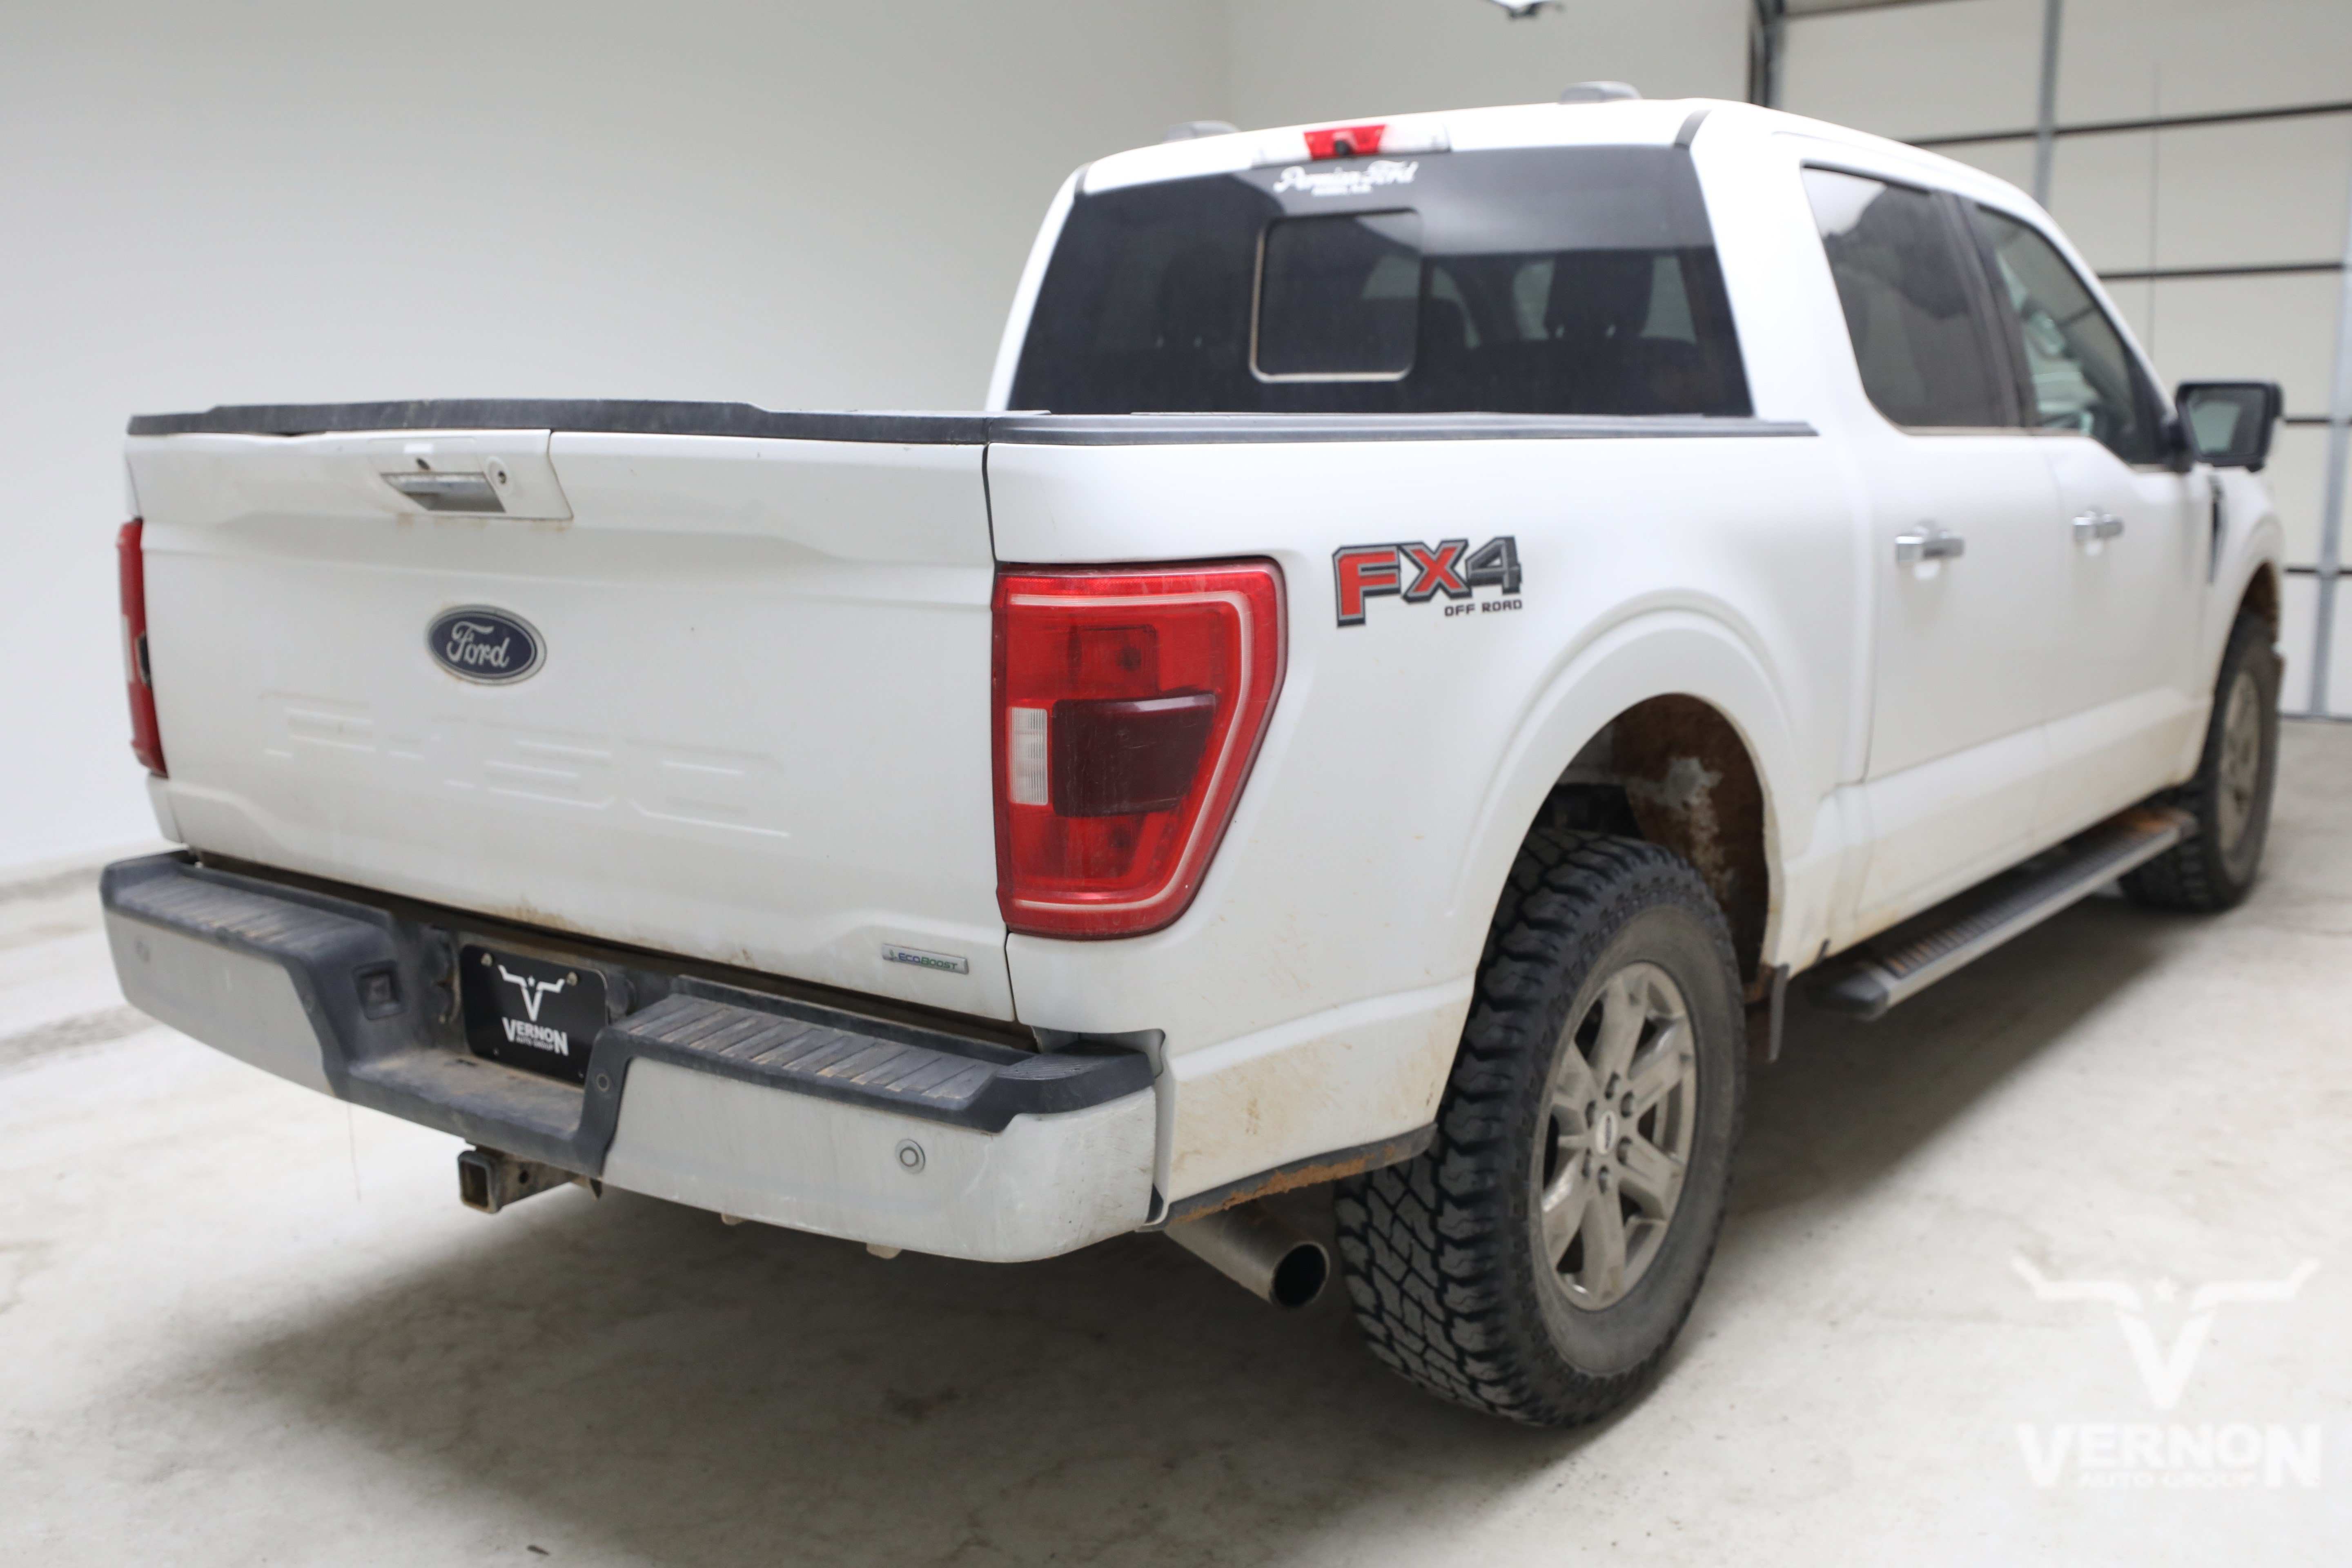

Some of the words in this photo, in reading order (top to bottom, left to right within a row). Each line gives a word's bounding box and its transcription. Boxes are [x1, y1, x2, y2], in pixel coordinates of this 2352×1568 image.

[1332, 535, 1522, 628] FX4
[1444, 603, 1475, 617] OFF
[1482, 599, 1522, 613] ROAD
[445, 620, 510, 668] Ford
[501, 1016, 569, 1056] VERNON
